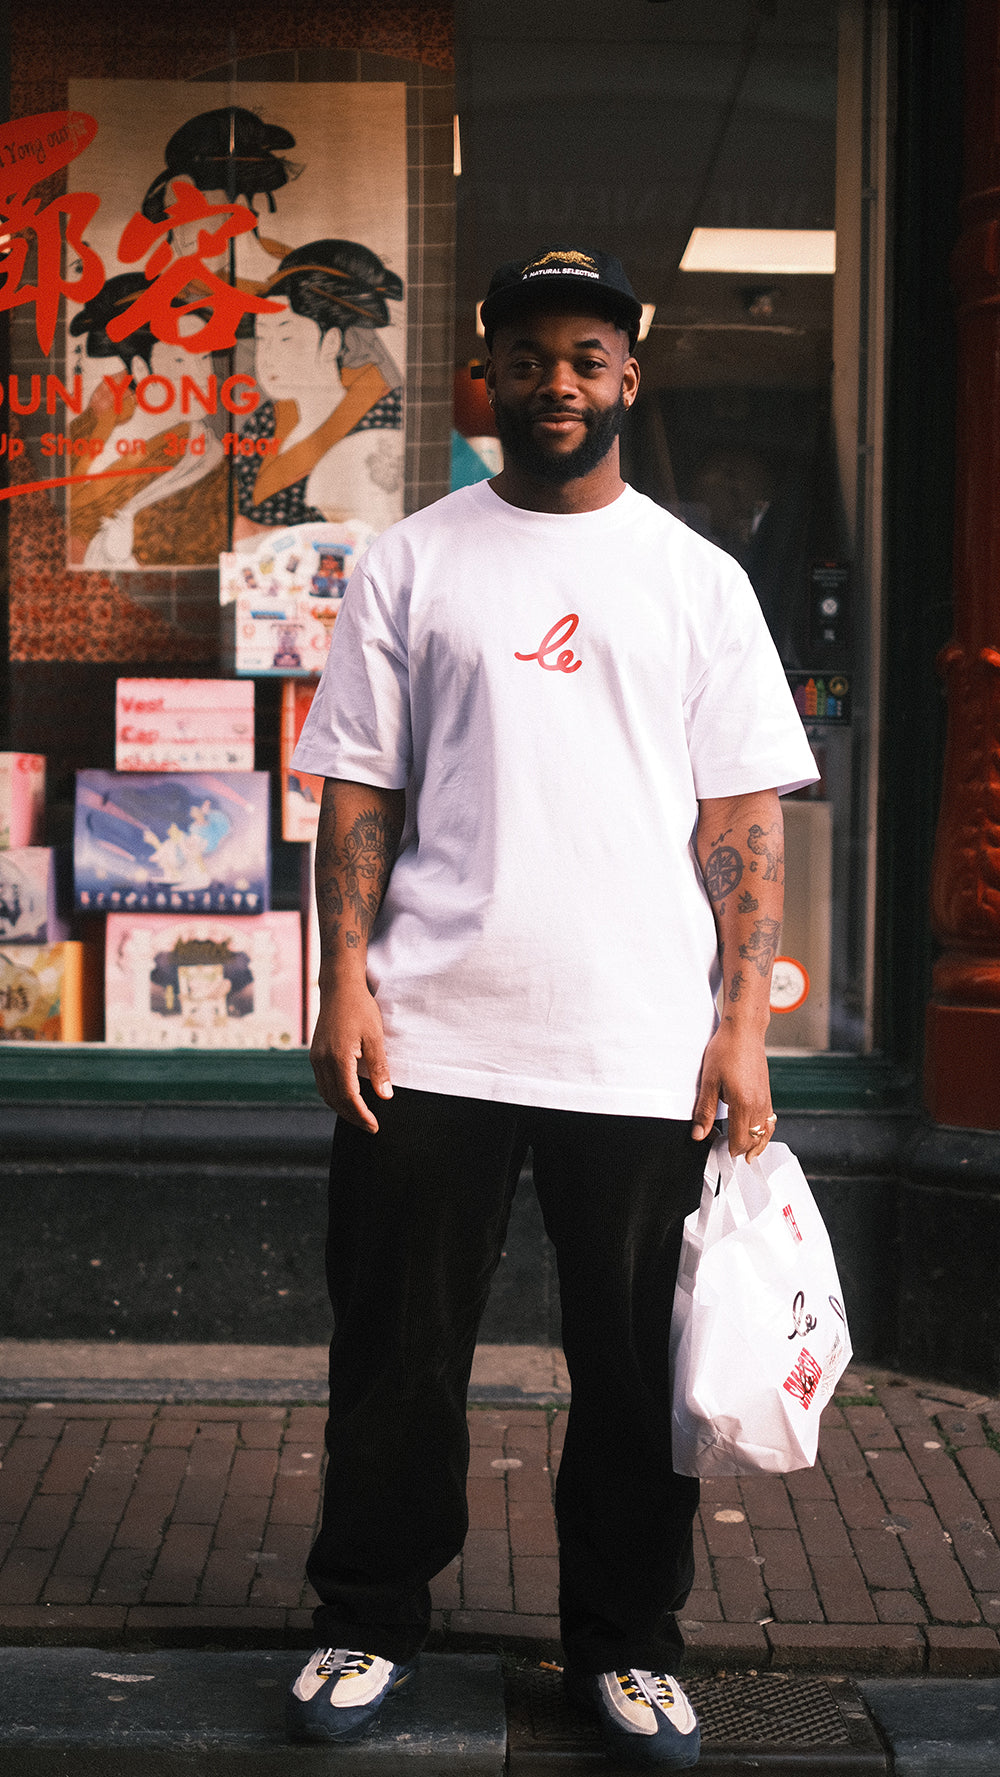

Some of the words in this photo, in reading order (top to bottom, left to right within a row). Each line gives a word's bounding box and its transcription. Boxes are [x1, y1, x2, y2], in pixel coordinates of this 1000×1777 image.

[4, 138, 47, 164] Yong
[529, 268, 561, 278] NATURAL
[561, 268, 600, 280] SELECTION
[0, 375, 83, 415] UN
[103, 373, 261, 415] YONG
[40, 433, 104, 459] Shop
[116, 438, 147, 456] on
[163, 433, 206, 456] 3rd
[223, 432, 282, 456] floor
[514, 613, 582, 673] le
